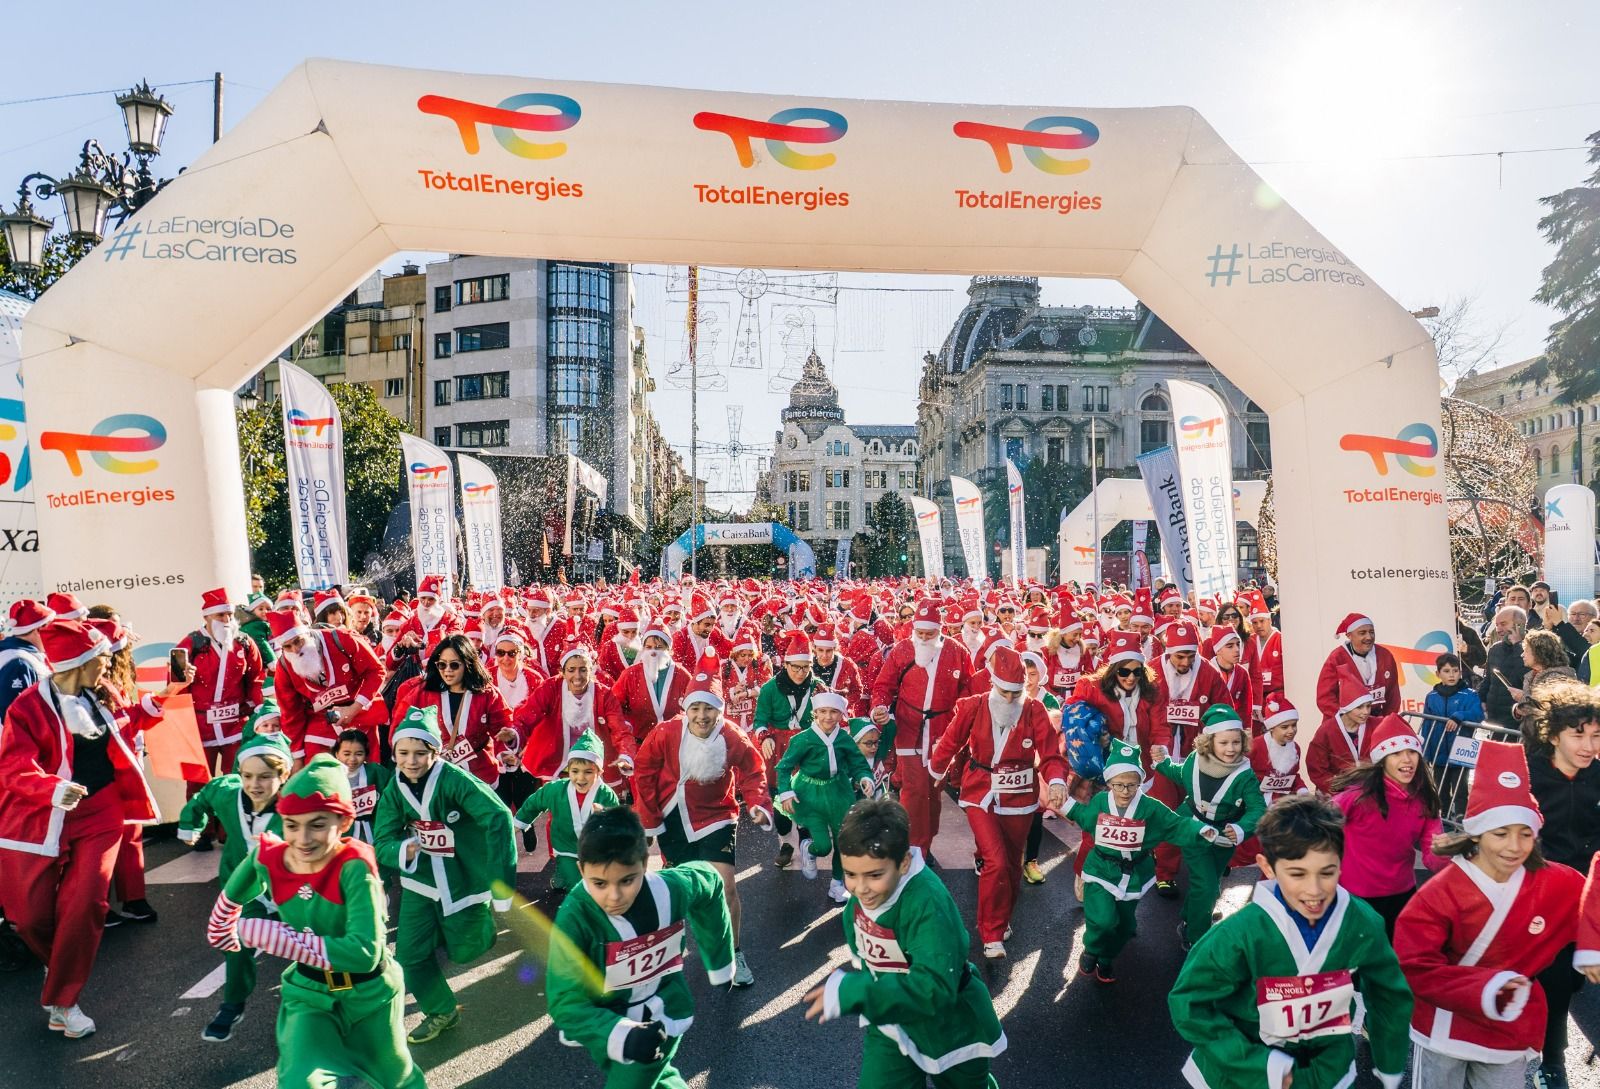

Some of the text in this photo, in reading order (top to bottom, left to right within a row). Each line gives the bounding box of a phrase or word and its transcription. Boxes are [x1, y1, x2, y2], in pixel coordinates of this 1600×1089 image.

[417, 169, 584, 201] TotalEnergies
[693, 183, 850, 211] TotalEnergies
[954, 188, 1103, 215] TotalEnergies
[142, 238, 298, 264] LasCarreras
[1247, 263, 1366, 287] LasCarreras
[784, 408, 842, 419] Banco Herrero
[47, 486, 176, 509] TotalEnergies
[1343, 487, 1444, 505] TotalEnergies
[721, 528, 771, 540] CaixaBank
[1350, 565, 1450, 581] totalenergies.es
[56, 572, 186, 593] totalenergies.es
[1060, 675, 1075, 683] 638
[317, 688, 344, 706] 1253
[212, 707, 237, 718] 1252
[1168, 707, 1195, 718] 2056
[997, 773, 1028, 786] 2481
[1266, 777, 1290, 787] 2057
[1102, 826, 1138, 843] 2483
[627, 946, 668, 977] 127
[1284, 986, 1304, 994] NOEL
[1281, 1000, 1333, 1028] 117
